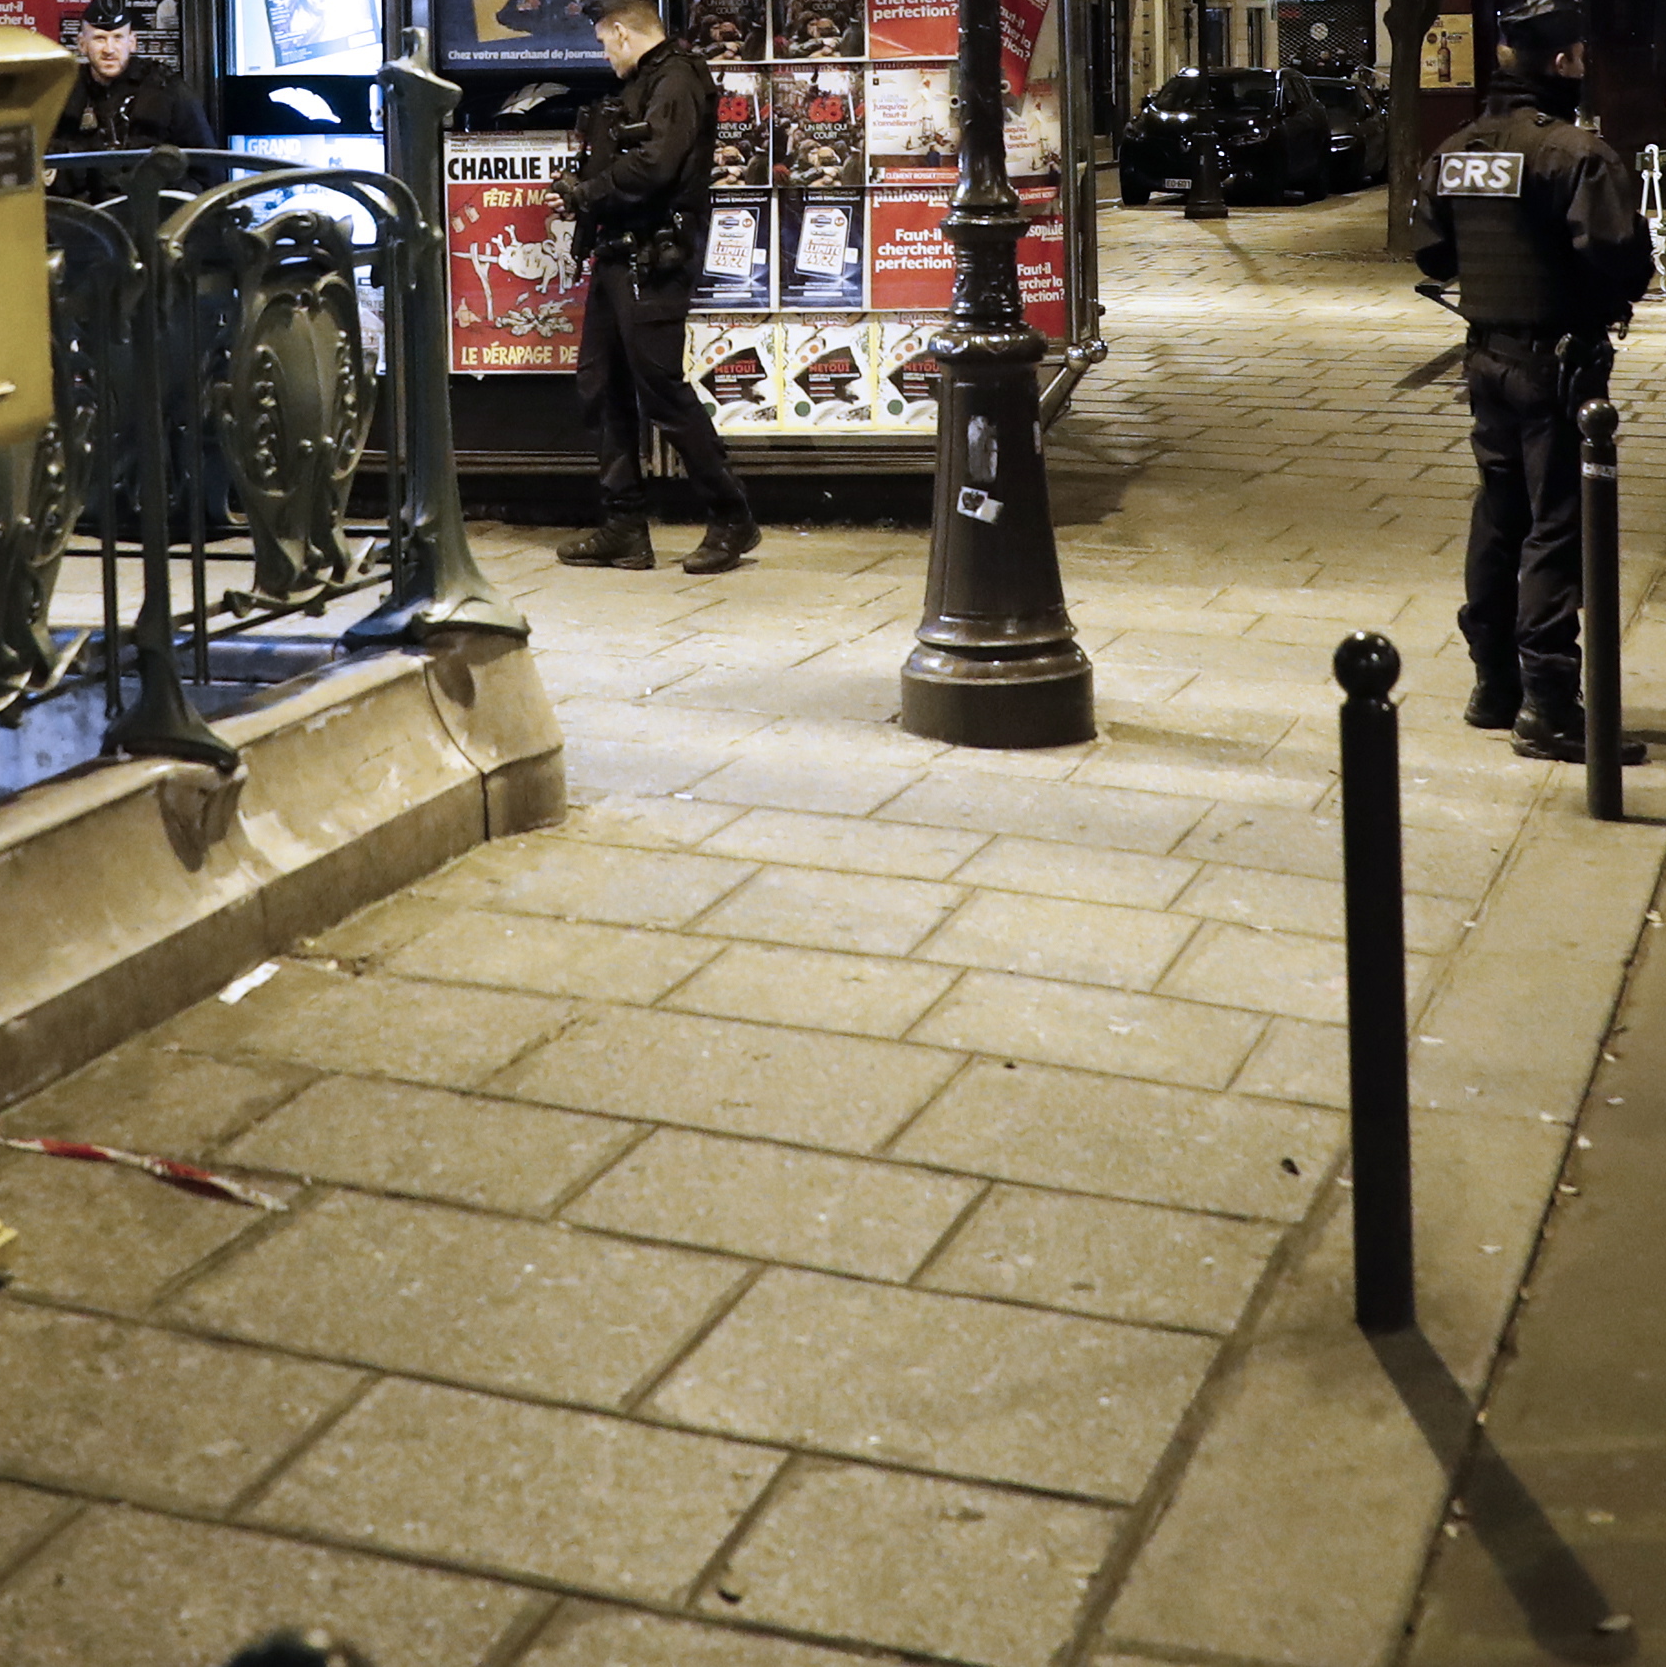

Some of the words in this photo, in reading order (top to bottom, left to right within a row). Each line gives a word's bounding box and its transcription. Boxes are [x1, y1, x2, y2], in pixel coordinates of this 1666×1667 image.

[812, 2, 837, 11] COURT
[873, 3, 959, 22] perfection?
[23, 14, 35, 26] la
[999, 6, 1026, 30] aut-il
[1021, 32, 1032, 50] la
[448, 50, 471, 61] Chez
[472, 51, 499, 61] votre
[501, 50, 550, 61] marchand
[550, 50, 564, 60] de
[808, 96, 844, 123] 68
[740, 122, 753, 132] QUI
[804, 122, 816, 132] UN
[835, 122, 848, 132] QUI
[718, 131, 742, 140] COURT
[813, 131, 838, 140] COURT
[248, 137, 302, 157] GRAND
[448, 157, 542, 180] CHARLIE
[1441, 157, 1513, 190] CRS
[483, 187, 512, 208] FÊTE
[512, 188, 524, 208] À
[873, 189, 950, 208] philosoph
[895, 229, 942, 243] Faut-il
[1027, 220, 1064, 242] sophie
[877, 242, 942, 256] chercher
[875, 256, 953, 273] perfection
[1016, 262, 1052, 276] Faut-il
[1019, 276, 1052, 290] ercher
[1052, 276, 1064, 288] la
[1021, 288, 1065, 304] fection?
[461, 346, 479, 366] LE
[483, 341, 553, 365] DÉRAPAGE
